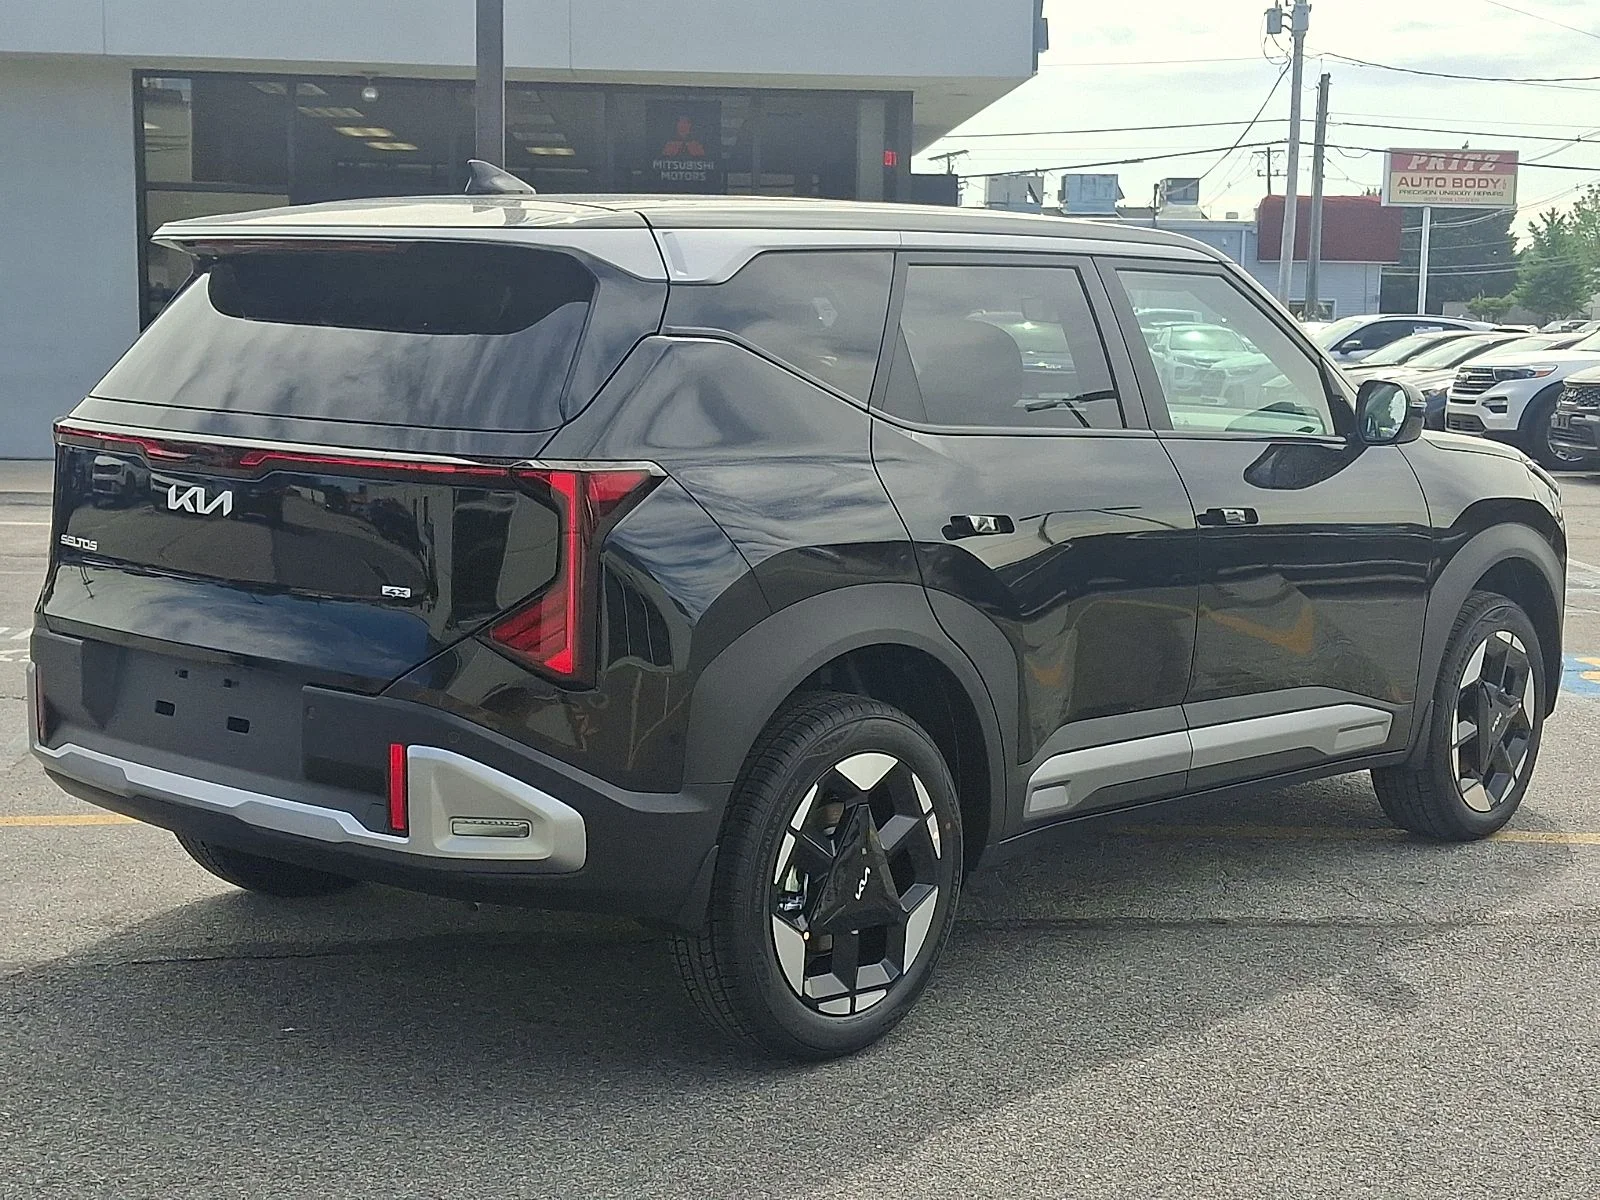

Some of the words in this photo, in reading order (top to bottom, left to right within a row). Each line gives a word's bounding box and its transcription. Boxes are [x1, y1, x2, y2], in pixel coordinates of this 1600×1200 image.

[653, 160, 714, 170] MITSUBISHI
[1408, 153, 1500, 171] PRITZ
[662, 172, 706, 181] MOTORS
[1398, 177, 1446, 188] AUTO
[1452, 177, 1501, 189] BODY
[167, 485, 232, 516] KIA
[60, 534, 98, 551] SELTOS
